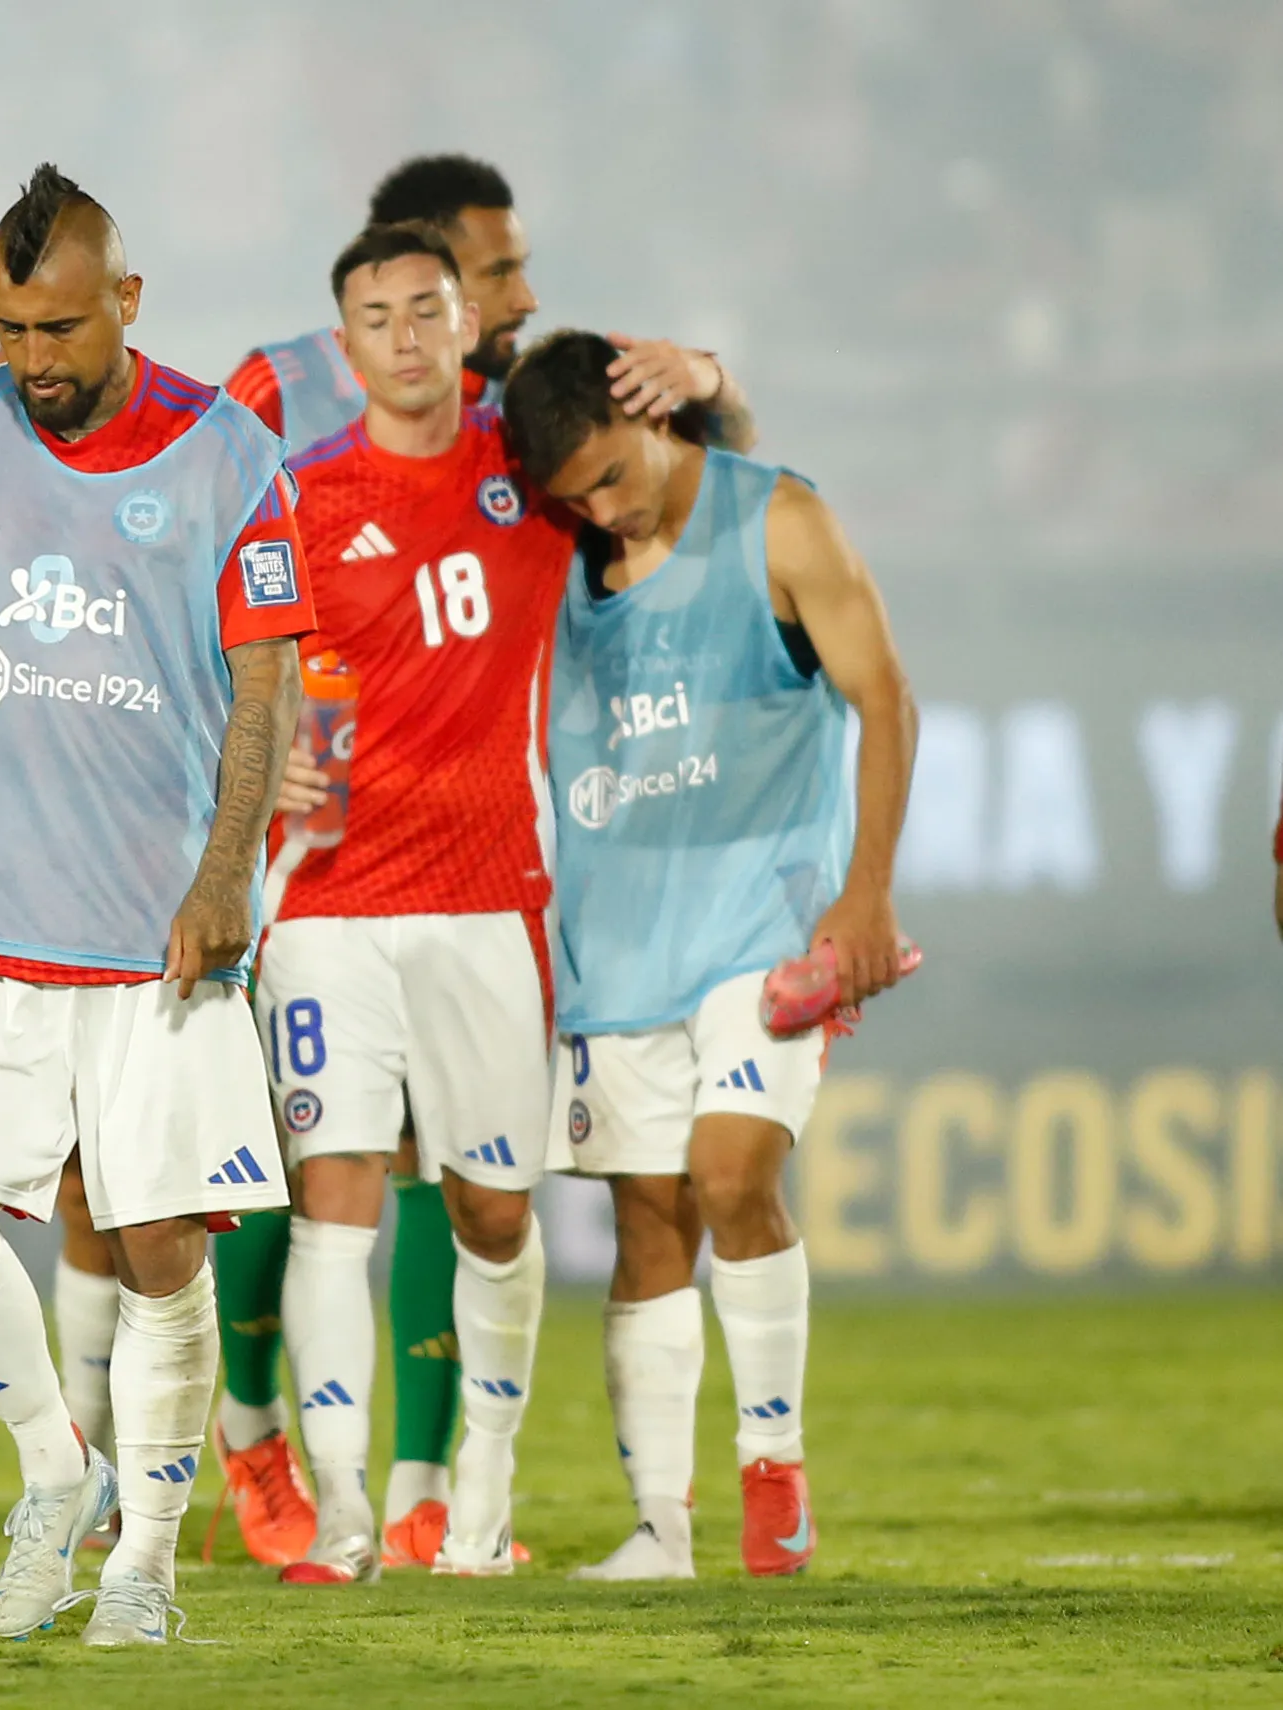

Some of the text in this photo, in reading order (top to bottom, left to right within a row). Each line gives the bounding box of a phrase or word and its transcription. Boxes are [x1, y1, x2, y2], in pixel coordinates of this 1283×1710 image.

[252, 560, 285, 575] UNITES
[51, 583, 127, 636] Bci
[415, 551, 491, 648] 18
[12, 663, 92, 702] Since
[97, 674, 162, 713] 1924
[631, 681, 690, 738] Bci
[269, 997, 328, 1084] 18
